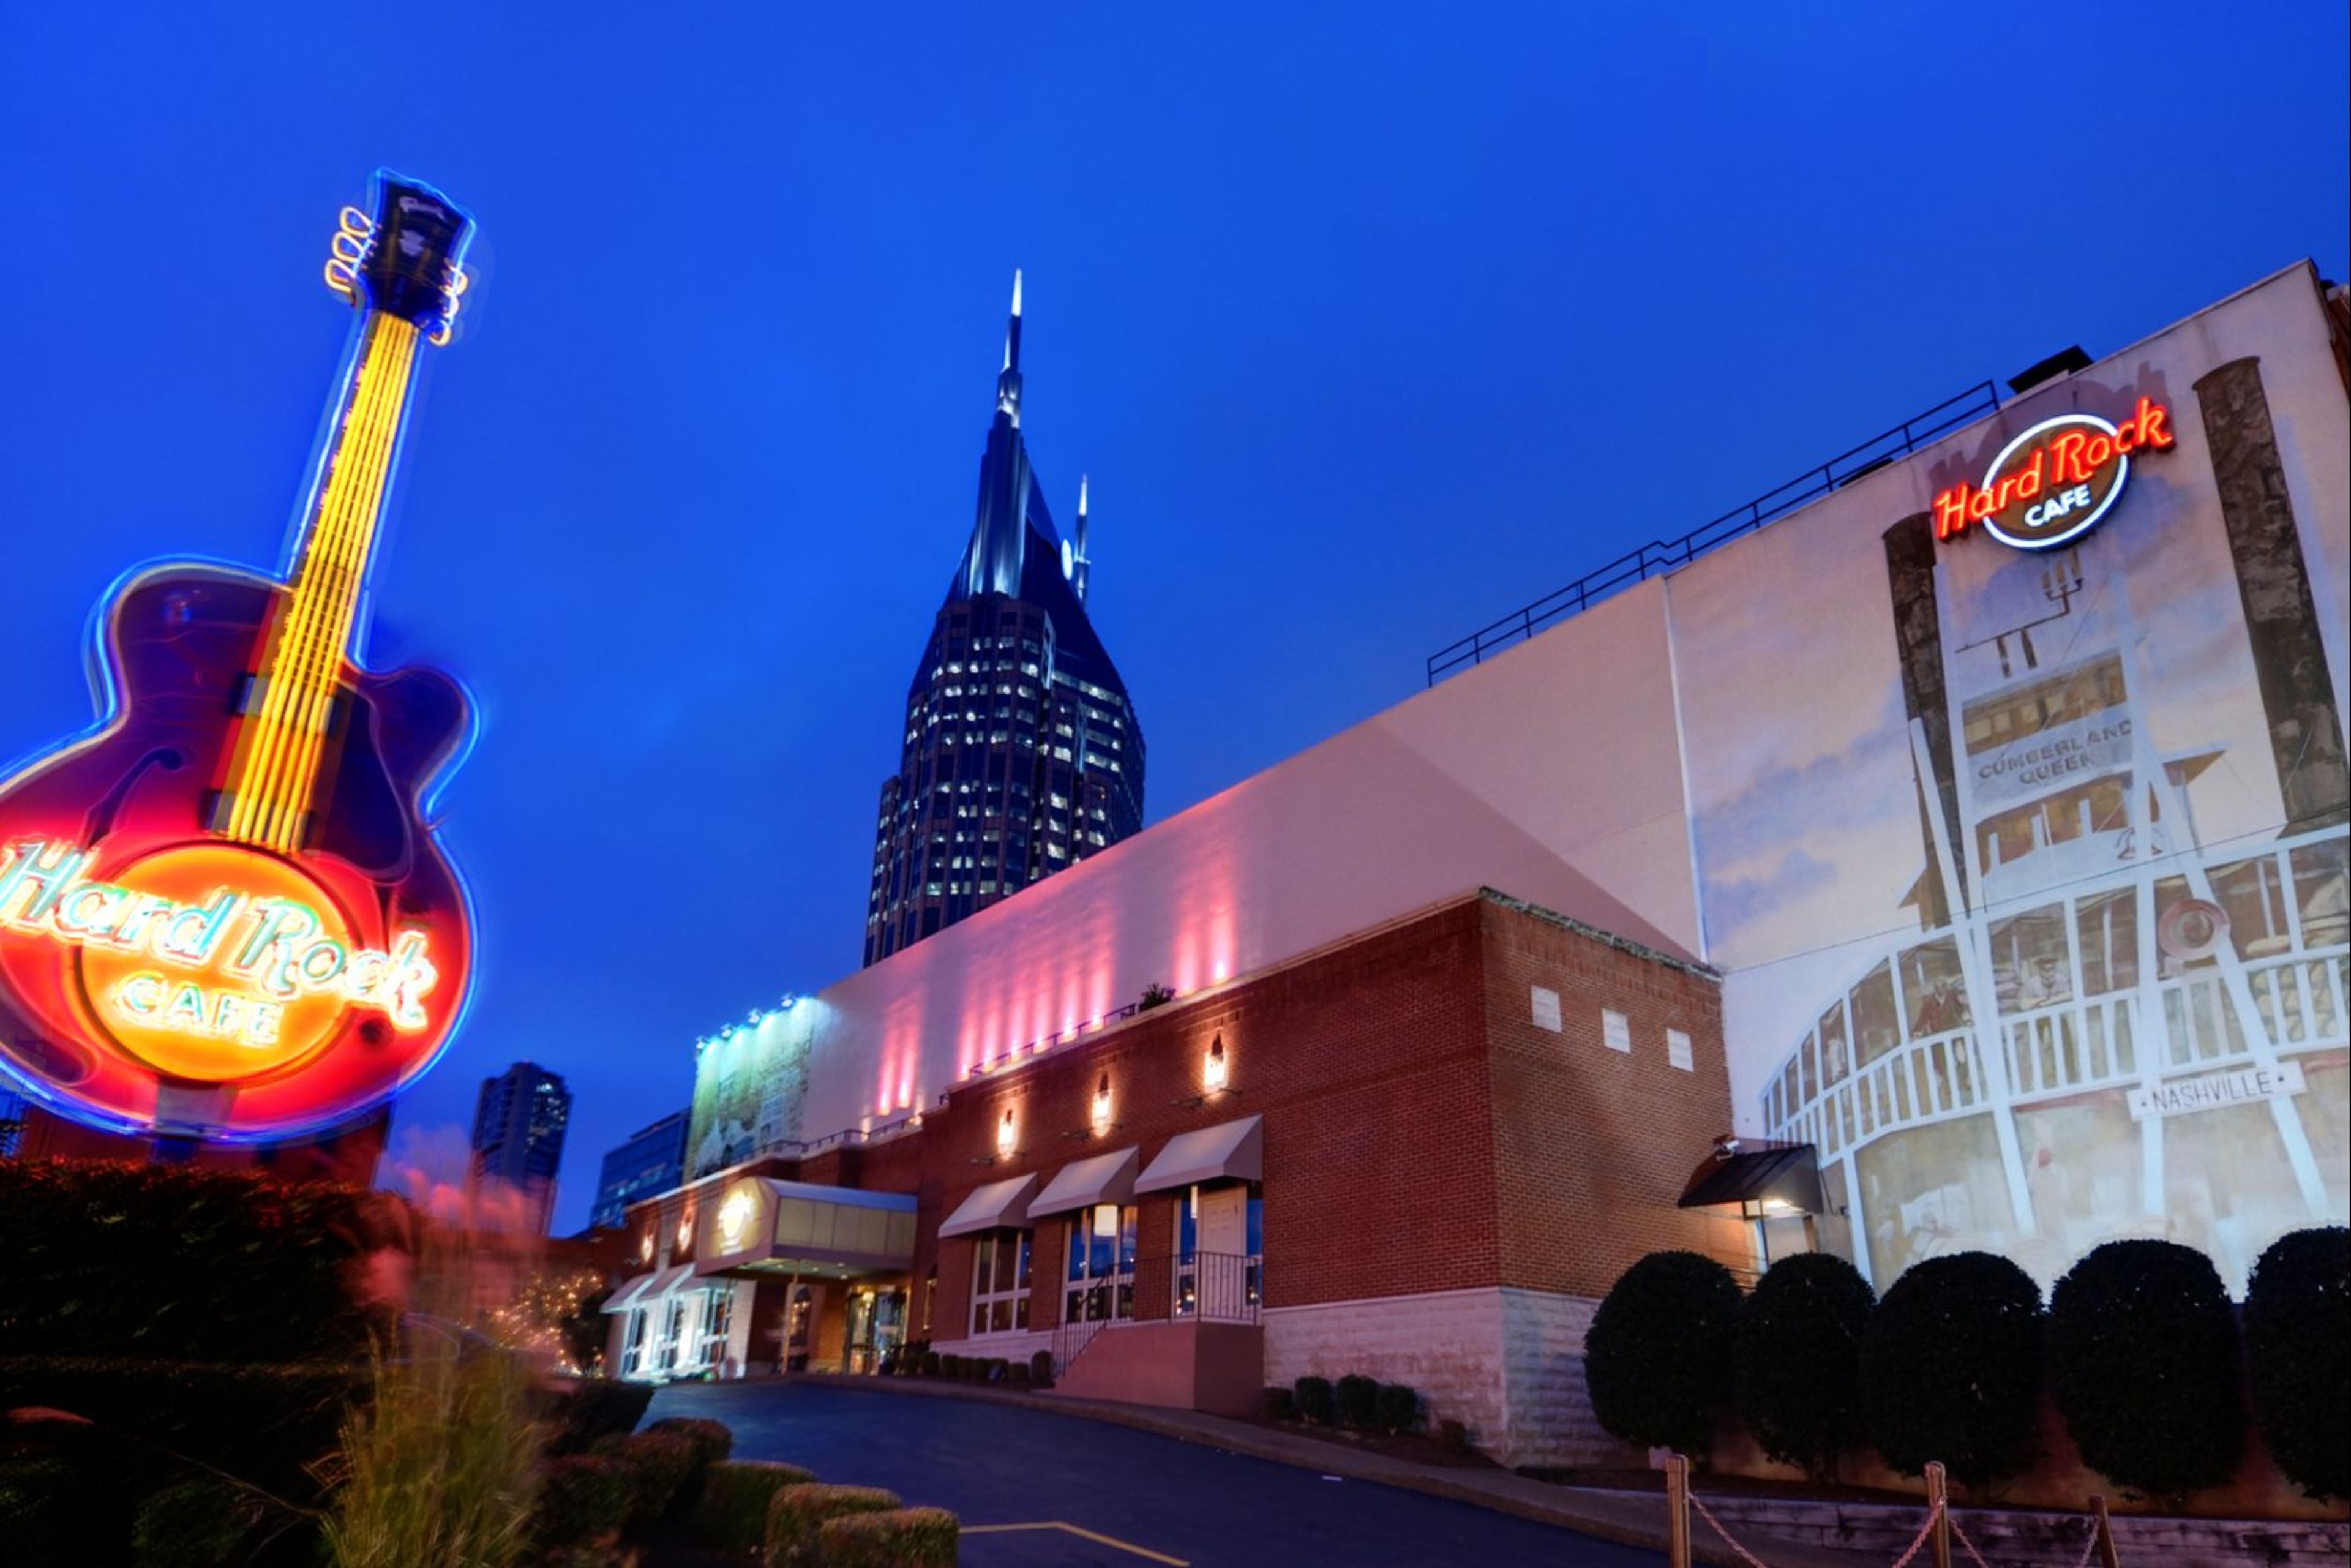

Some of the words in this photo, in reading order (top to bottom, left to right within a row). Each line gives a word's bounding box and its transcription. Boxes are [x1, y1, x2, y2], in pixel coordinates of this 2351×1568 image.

[1933, 449, 2044, 540] Hard
[2050, 396, 2173, 484] Rock
[2024, 483, 2091, 528] CAFE
[0, 836, 240, 967] Hard
[225, 895, 437, 1029] Rock
[114, 970, 283, 1047] CAFE
[2152, 1071, 2273, 1111] NASHVILLE
